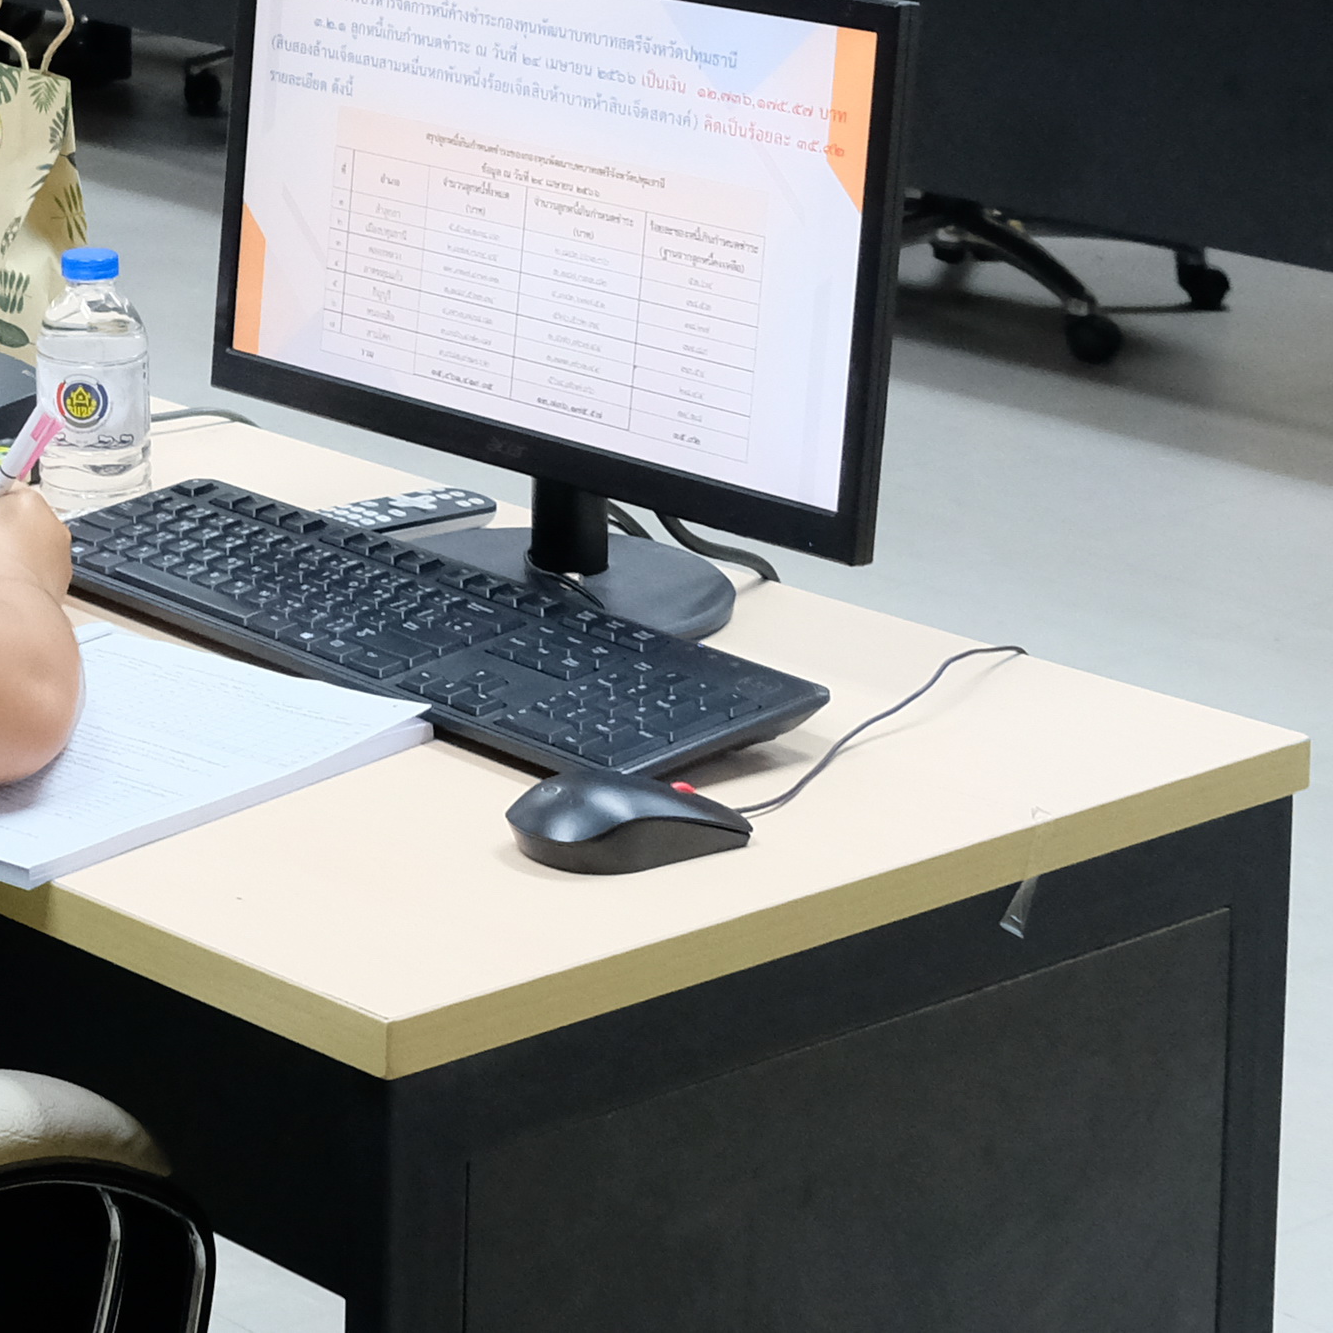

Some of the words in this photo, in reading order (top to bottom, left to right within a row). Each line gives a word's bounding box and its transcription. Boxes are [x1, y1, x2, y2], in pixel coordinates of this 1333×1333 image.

[331, 74, 354, 98] ดังนี้
[491, 42, 518, 64] วันที่
[819, 105, 847, 124] บาท
